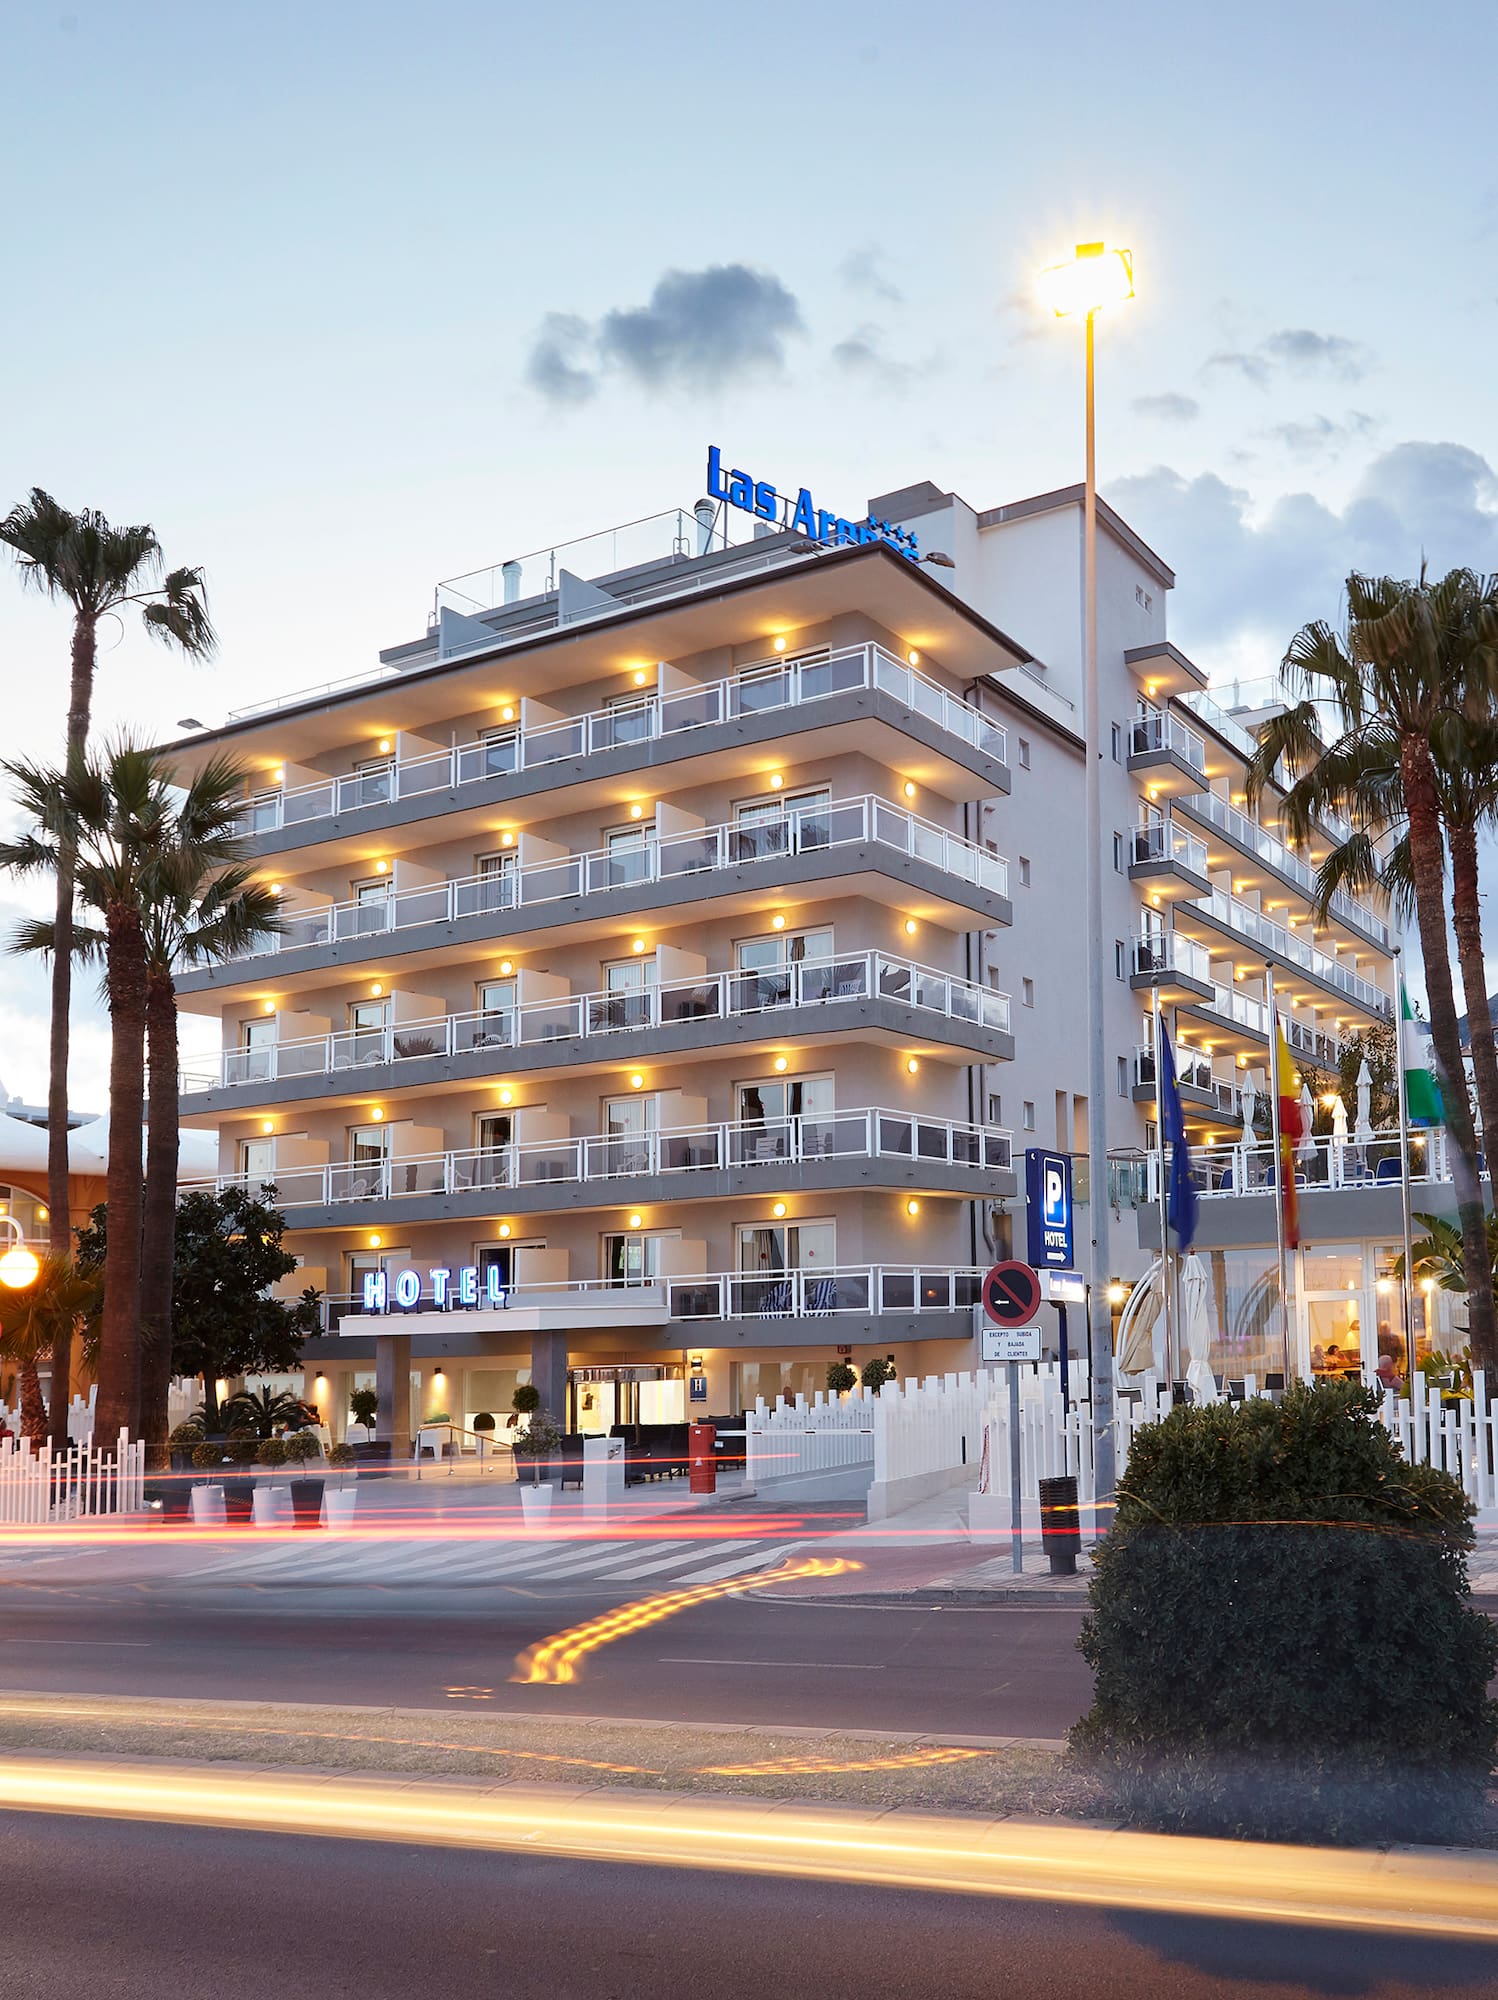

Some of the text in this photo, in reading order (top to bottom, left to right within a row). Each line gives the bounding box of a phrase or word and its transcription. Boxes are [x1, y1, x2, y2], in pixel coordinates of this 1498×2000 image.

[706, 445, 920, 563] Las Are
[1047, 1170, 1062, 1214] P
[1044, 1230, 1068, 1248] HOTEL
[364, 1264, 507, 1309] HOTEL
[694, 1379, 702, 1391] H
